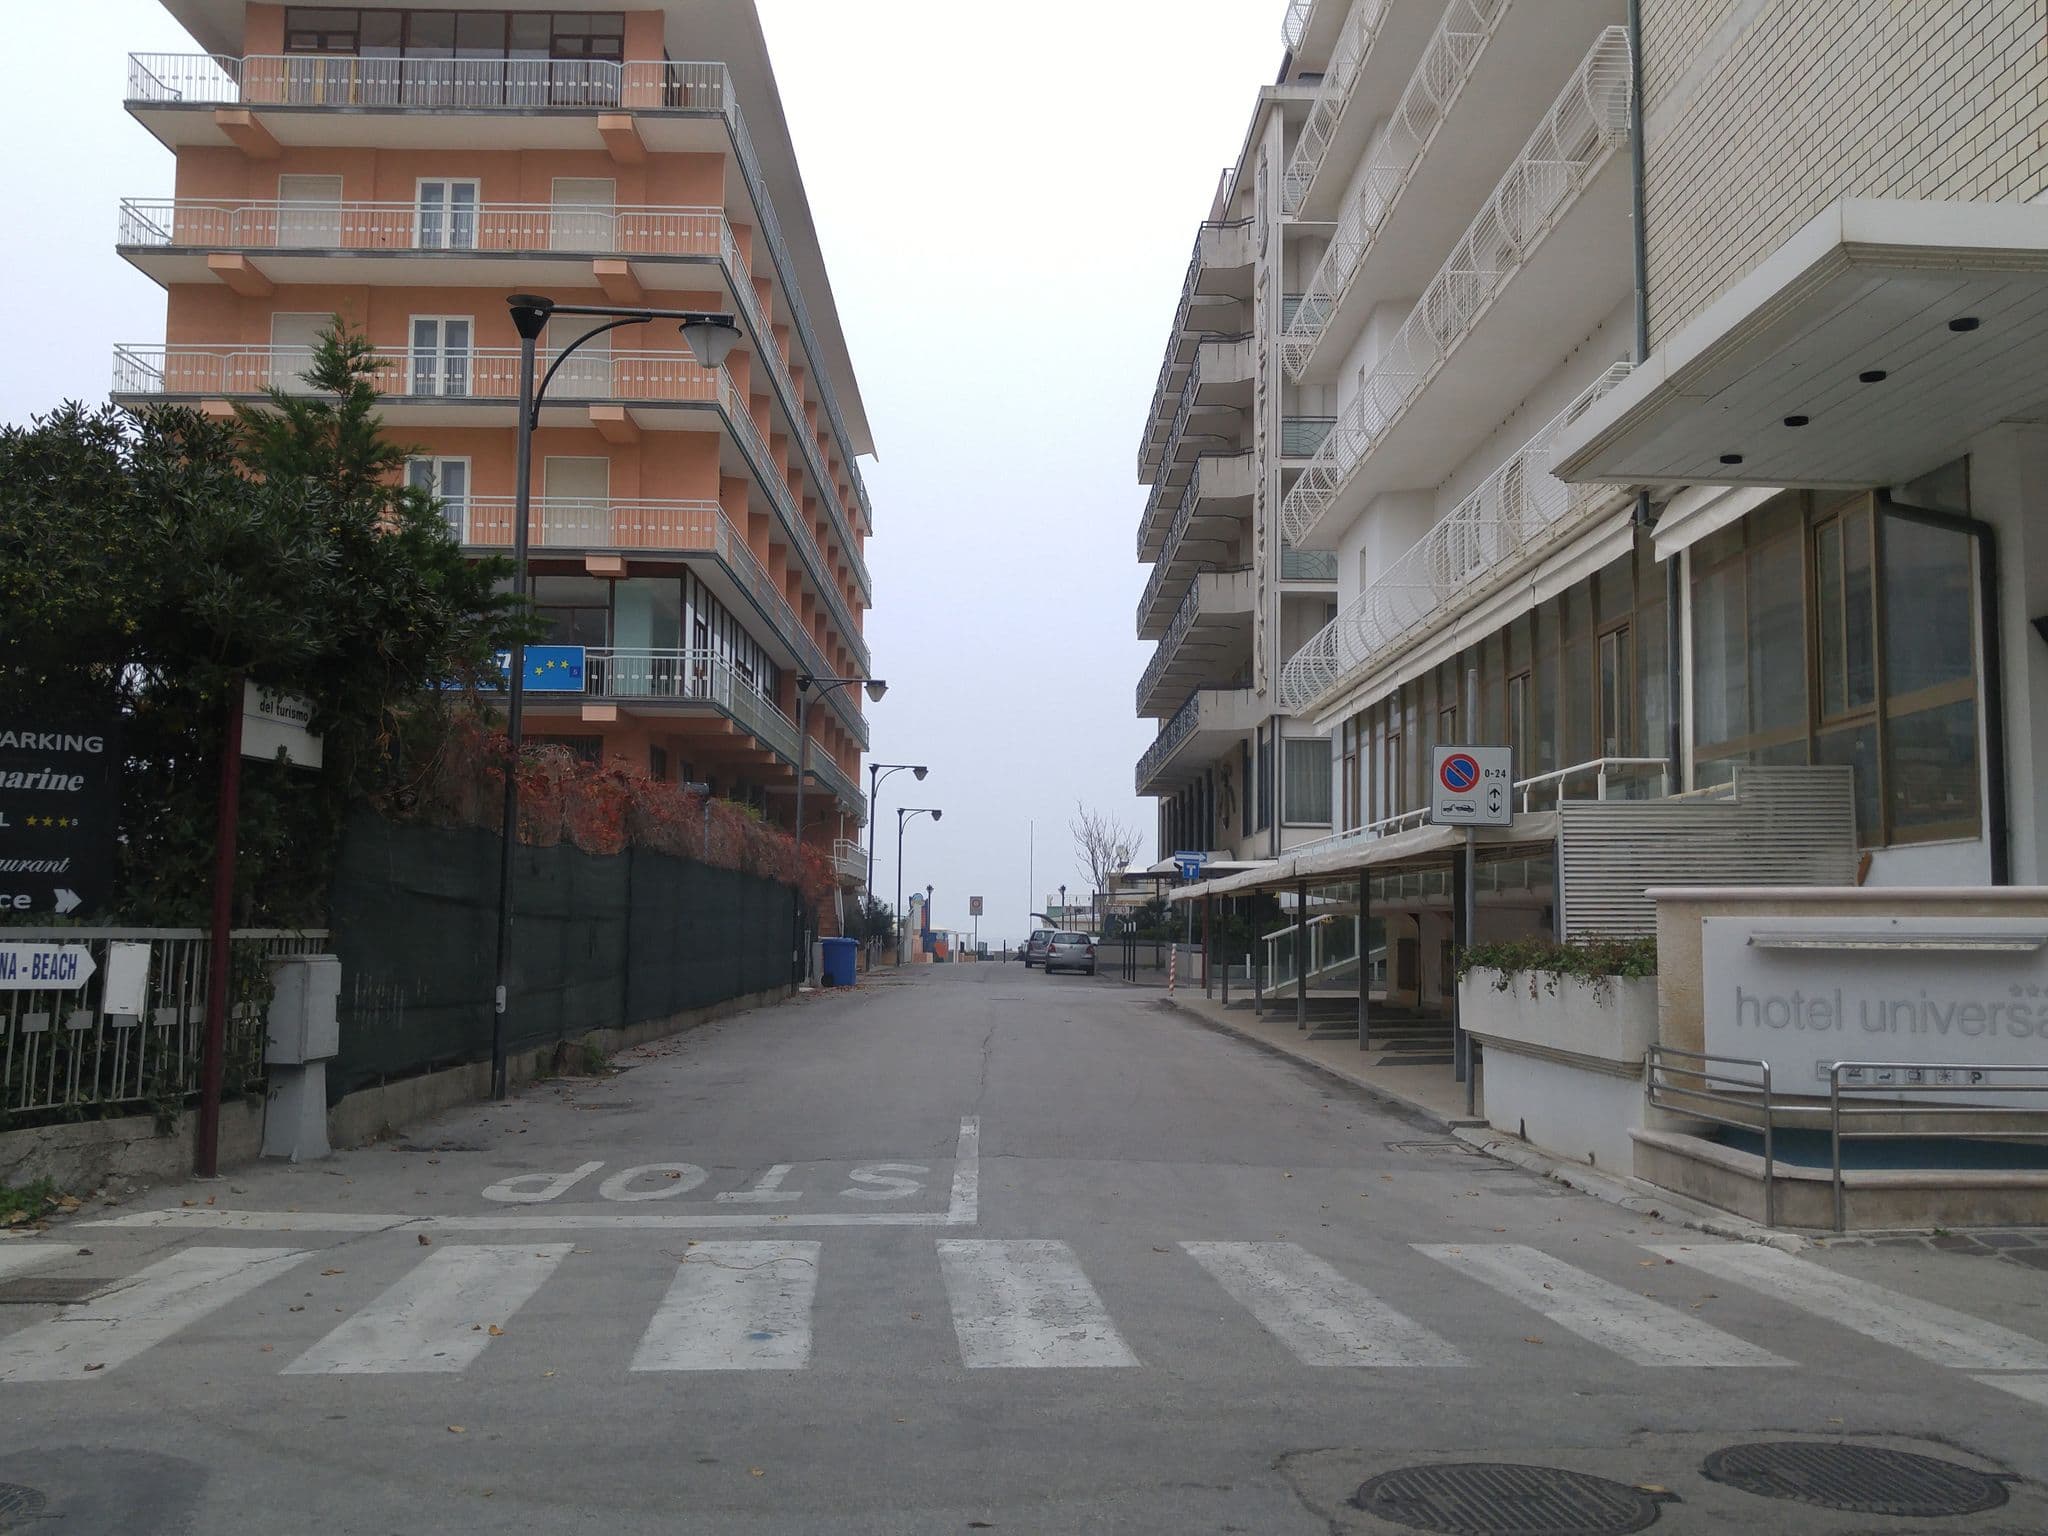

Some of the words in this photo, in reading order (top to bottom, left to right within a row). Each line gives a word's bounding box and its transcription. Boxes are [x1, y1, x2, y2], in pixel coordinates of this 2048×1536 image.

[259, 699, 274, 713] del
[276, 705, 309, 722] turismo
[0, 730, 104, 753] ARKING
[1484, 768, 1507, 779] 0-24
[31, 952, 78, 980] BEACH
[1735, 985, 1843, 1031] hotel
[481, 1160, 930, 1203] STOP
